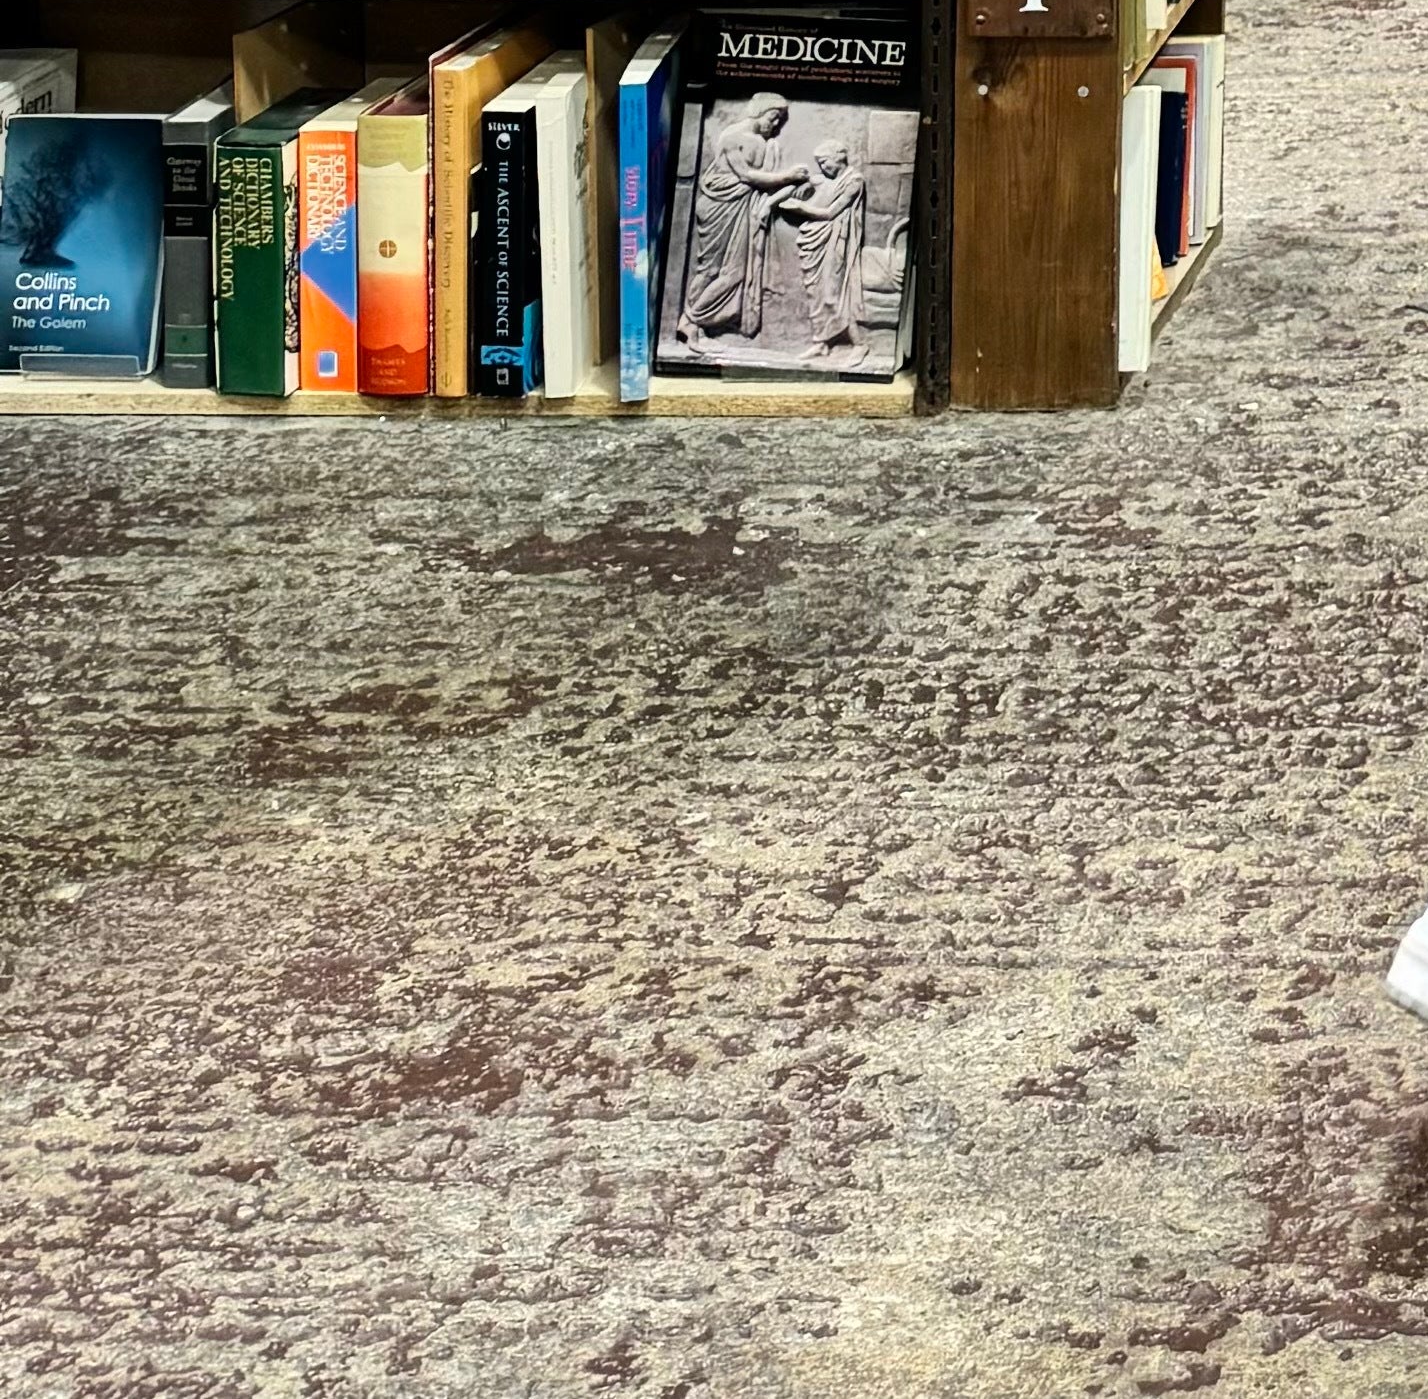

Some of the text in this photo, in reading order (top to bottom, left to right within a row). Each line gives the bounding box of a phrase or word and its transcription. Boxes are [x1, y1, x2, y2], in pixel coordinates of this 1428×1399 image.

[717, 32, 906, 67] MEDICINE
[259, 158, 274, 244] CHAMBERS
[496, 161, 510, 338] THE ASCENT OF SCIENCE
[16, 273, 77, 291] Collins
[13, 293, 110, 312] and Pinch
[12, 317, 87, 330] The Golem
